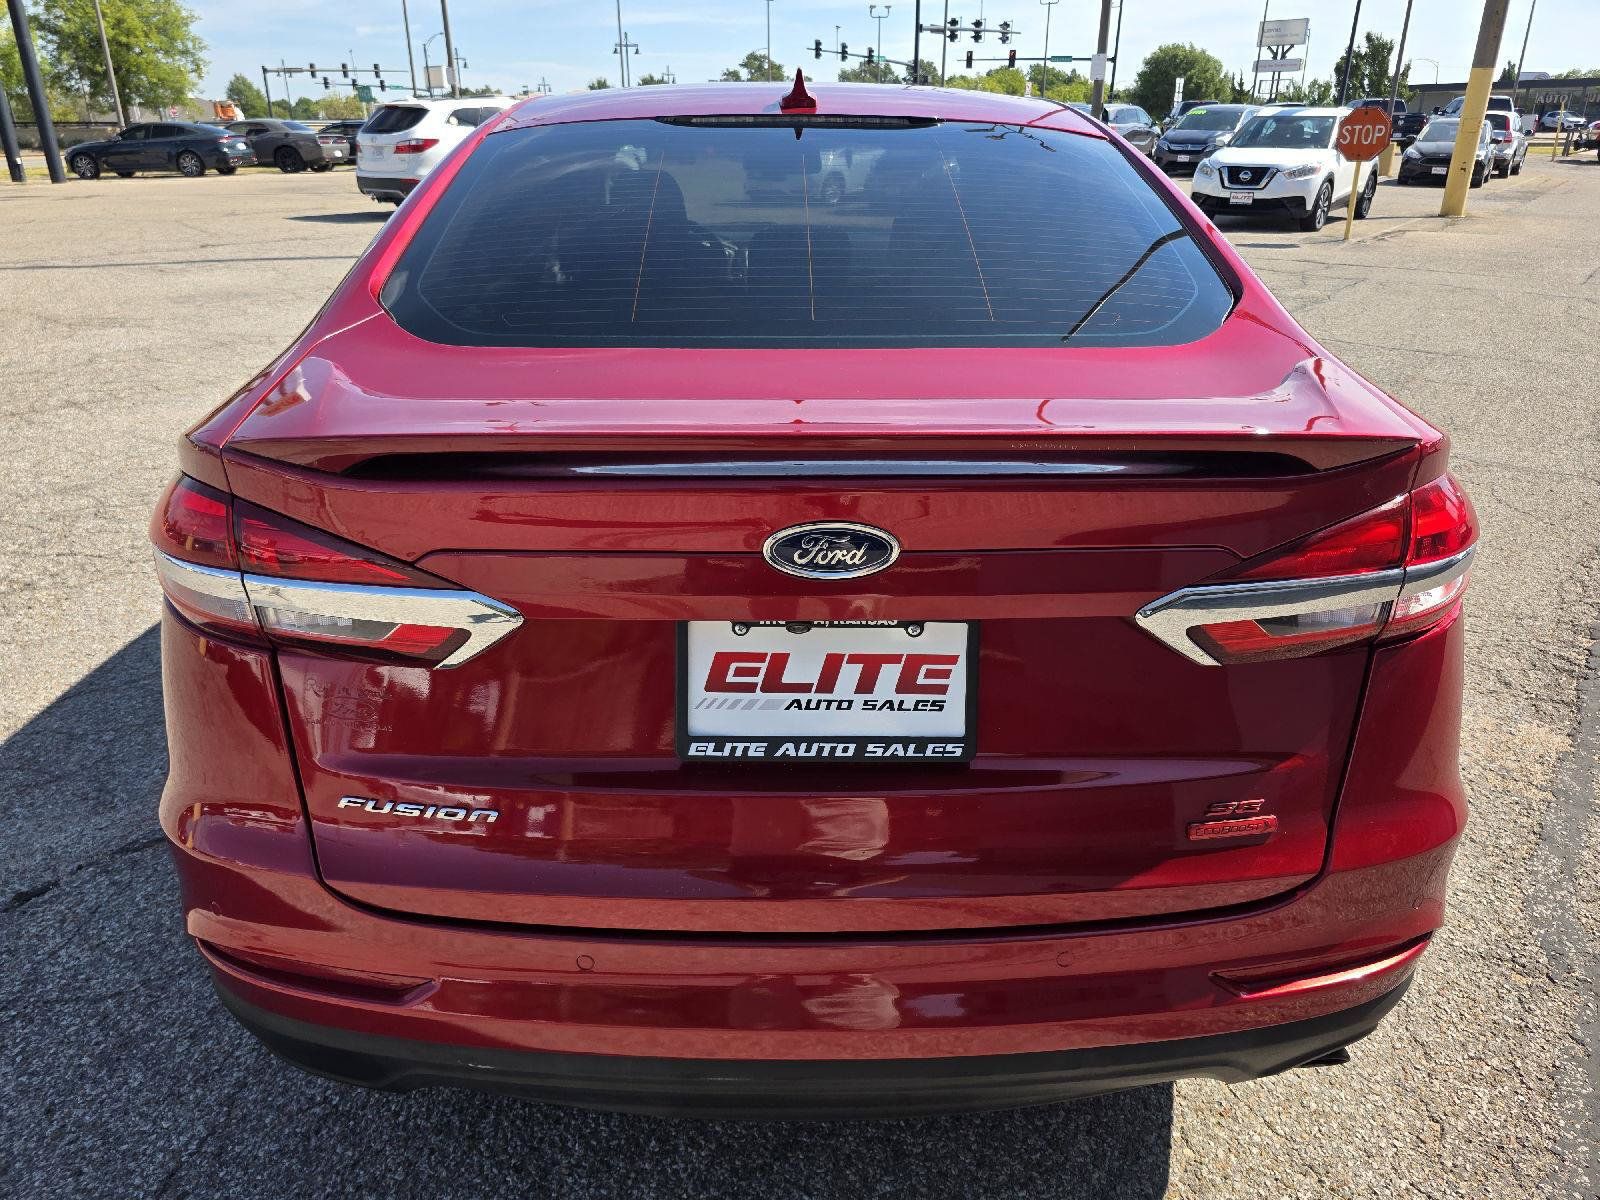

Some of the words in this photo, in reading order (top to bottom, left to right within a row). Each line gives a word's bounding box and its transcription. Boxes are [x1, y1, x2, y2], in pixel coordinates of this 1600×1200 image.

[1340, 125, 1386, 145] STOP
[793, 534, 869, 565] Ford
[703, 651, 961, 695] ELITE
[784, 698, 853, 712] AUTO
[861, 699, 947, 713] SALES
[687, 741, 769, 757] ELITE
[773, 742, 857, 757] AUTO
[864, 743, 965, 758] SALES
[337, 795, 499, 823] FUSION
